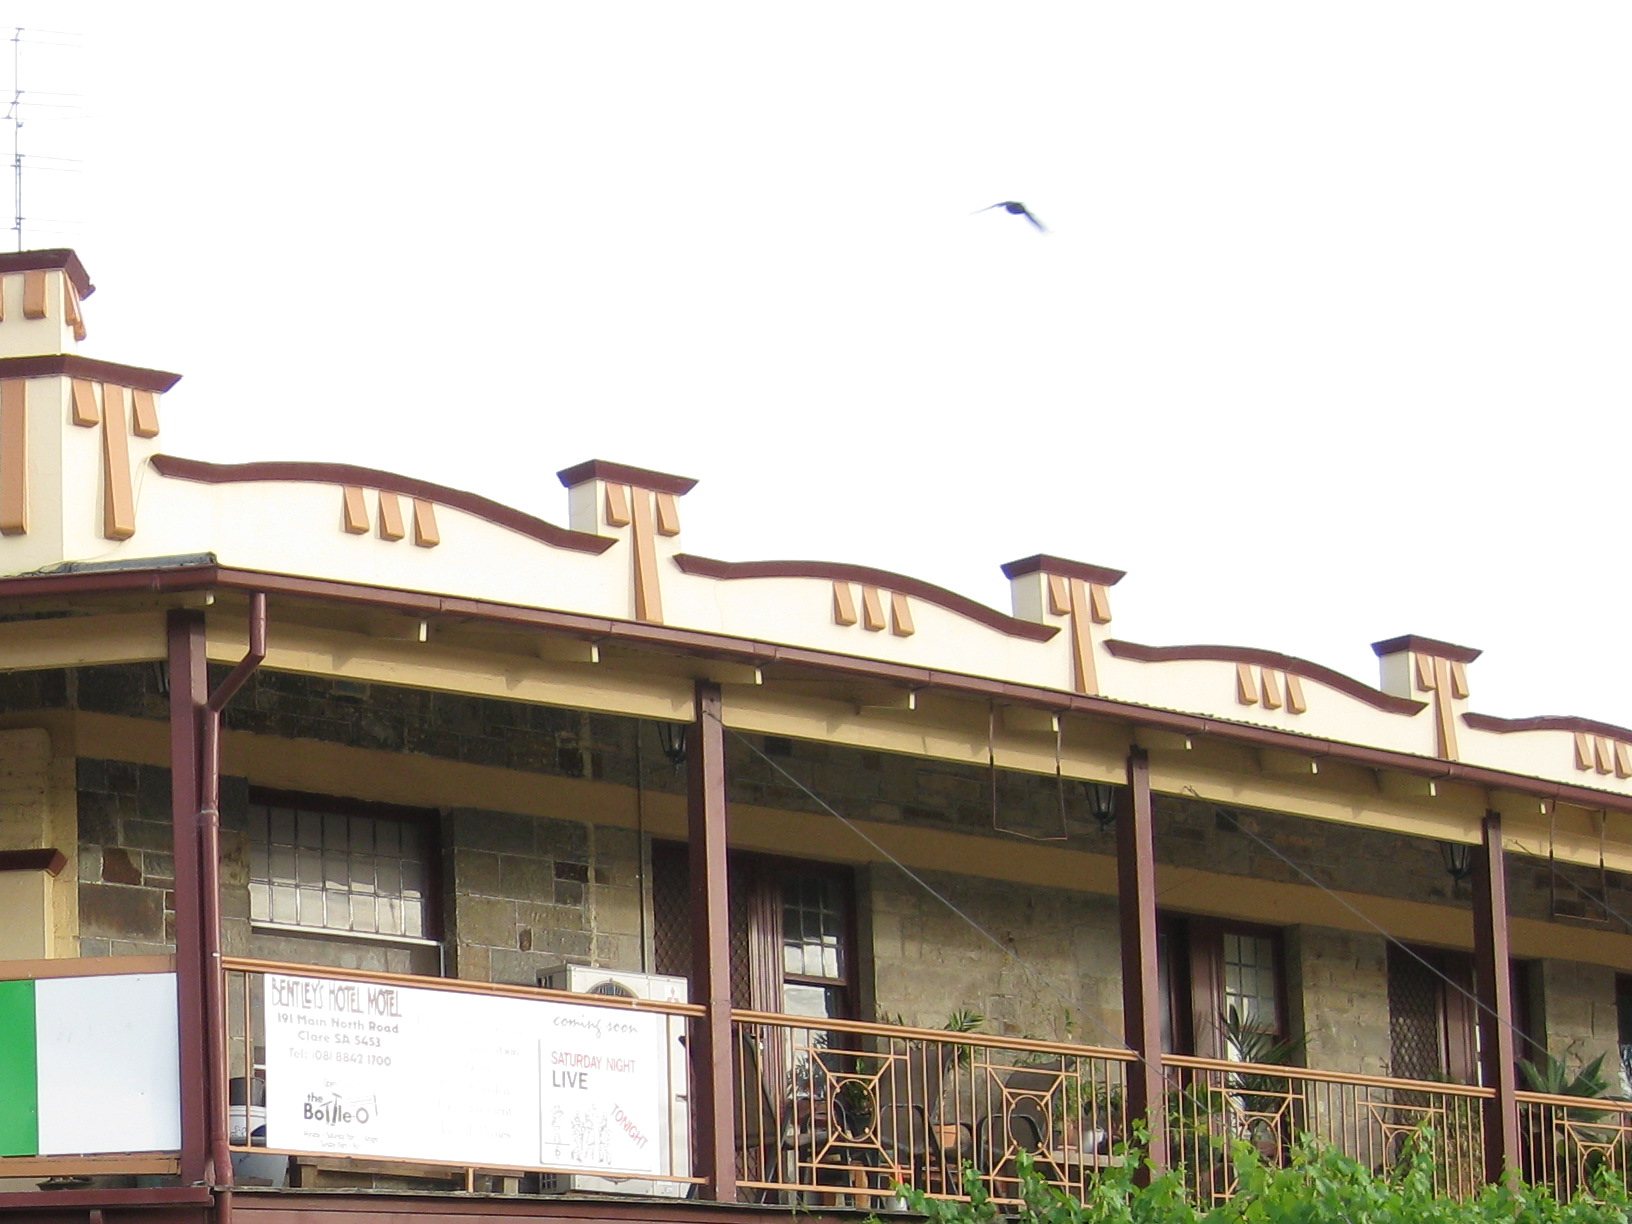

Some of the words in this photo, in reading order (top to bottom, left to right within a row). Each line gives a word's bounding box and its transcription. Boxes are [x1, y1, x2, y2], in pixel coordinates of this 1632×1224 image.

[271, 976, 324, 1009] BENTLEY'S
[329, 981, 364, 1014] HOTEL
[368, 987, 402, 1018] MOTEL
[277, 1012, 294, 1024] 191
[297, 1014, 327, 1027] Main
[331, 1017, 365, 1031] North
[369, 1020, 399, 1034] Road
[553, 1015, 603, 1040] coming
[298, 1030, 330, 1044] Clare
[334, 1033, 351, 1045] SA
[354, 1035, 381, 1048] 5453
[335, 1051, 363, 1064] 8842
[551, 1051, 603, 1071] SATURDAY
[606, 1056, 637, 1074] NIGHT
[552, 1070, 589, 1091] LIVE
[307, 1092, 323, 1104] the
[609, 1103, 648, 1150] TONIGHT
